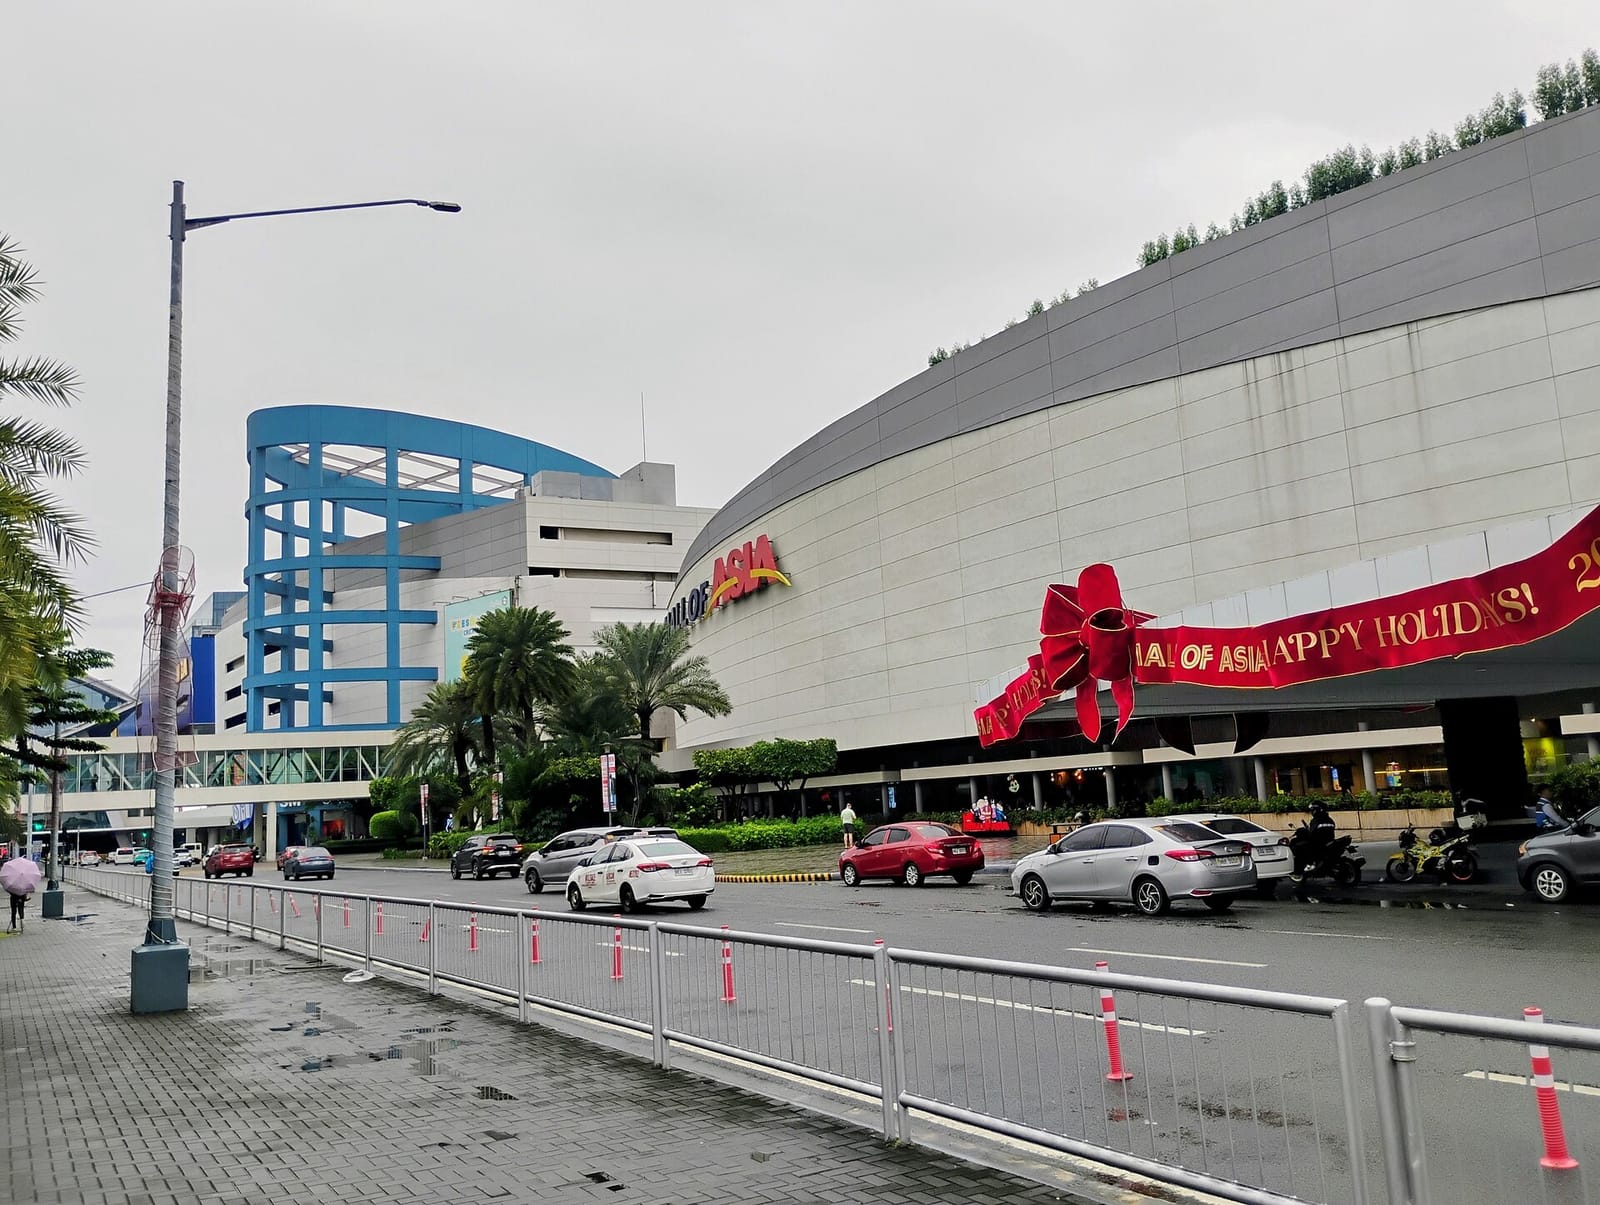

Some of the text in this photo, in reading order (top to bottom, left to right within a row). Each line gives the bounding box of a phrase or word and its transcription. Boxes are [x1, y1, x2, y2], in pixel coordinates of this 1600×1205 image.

[688, 580, 710, 622] OF
[712, 534, 778, 609] ASIA
[1181, 644, 1214, 670] OF
[1219, 645, 1269, 673] ASIA
